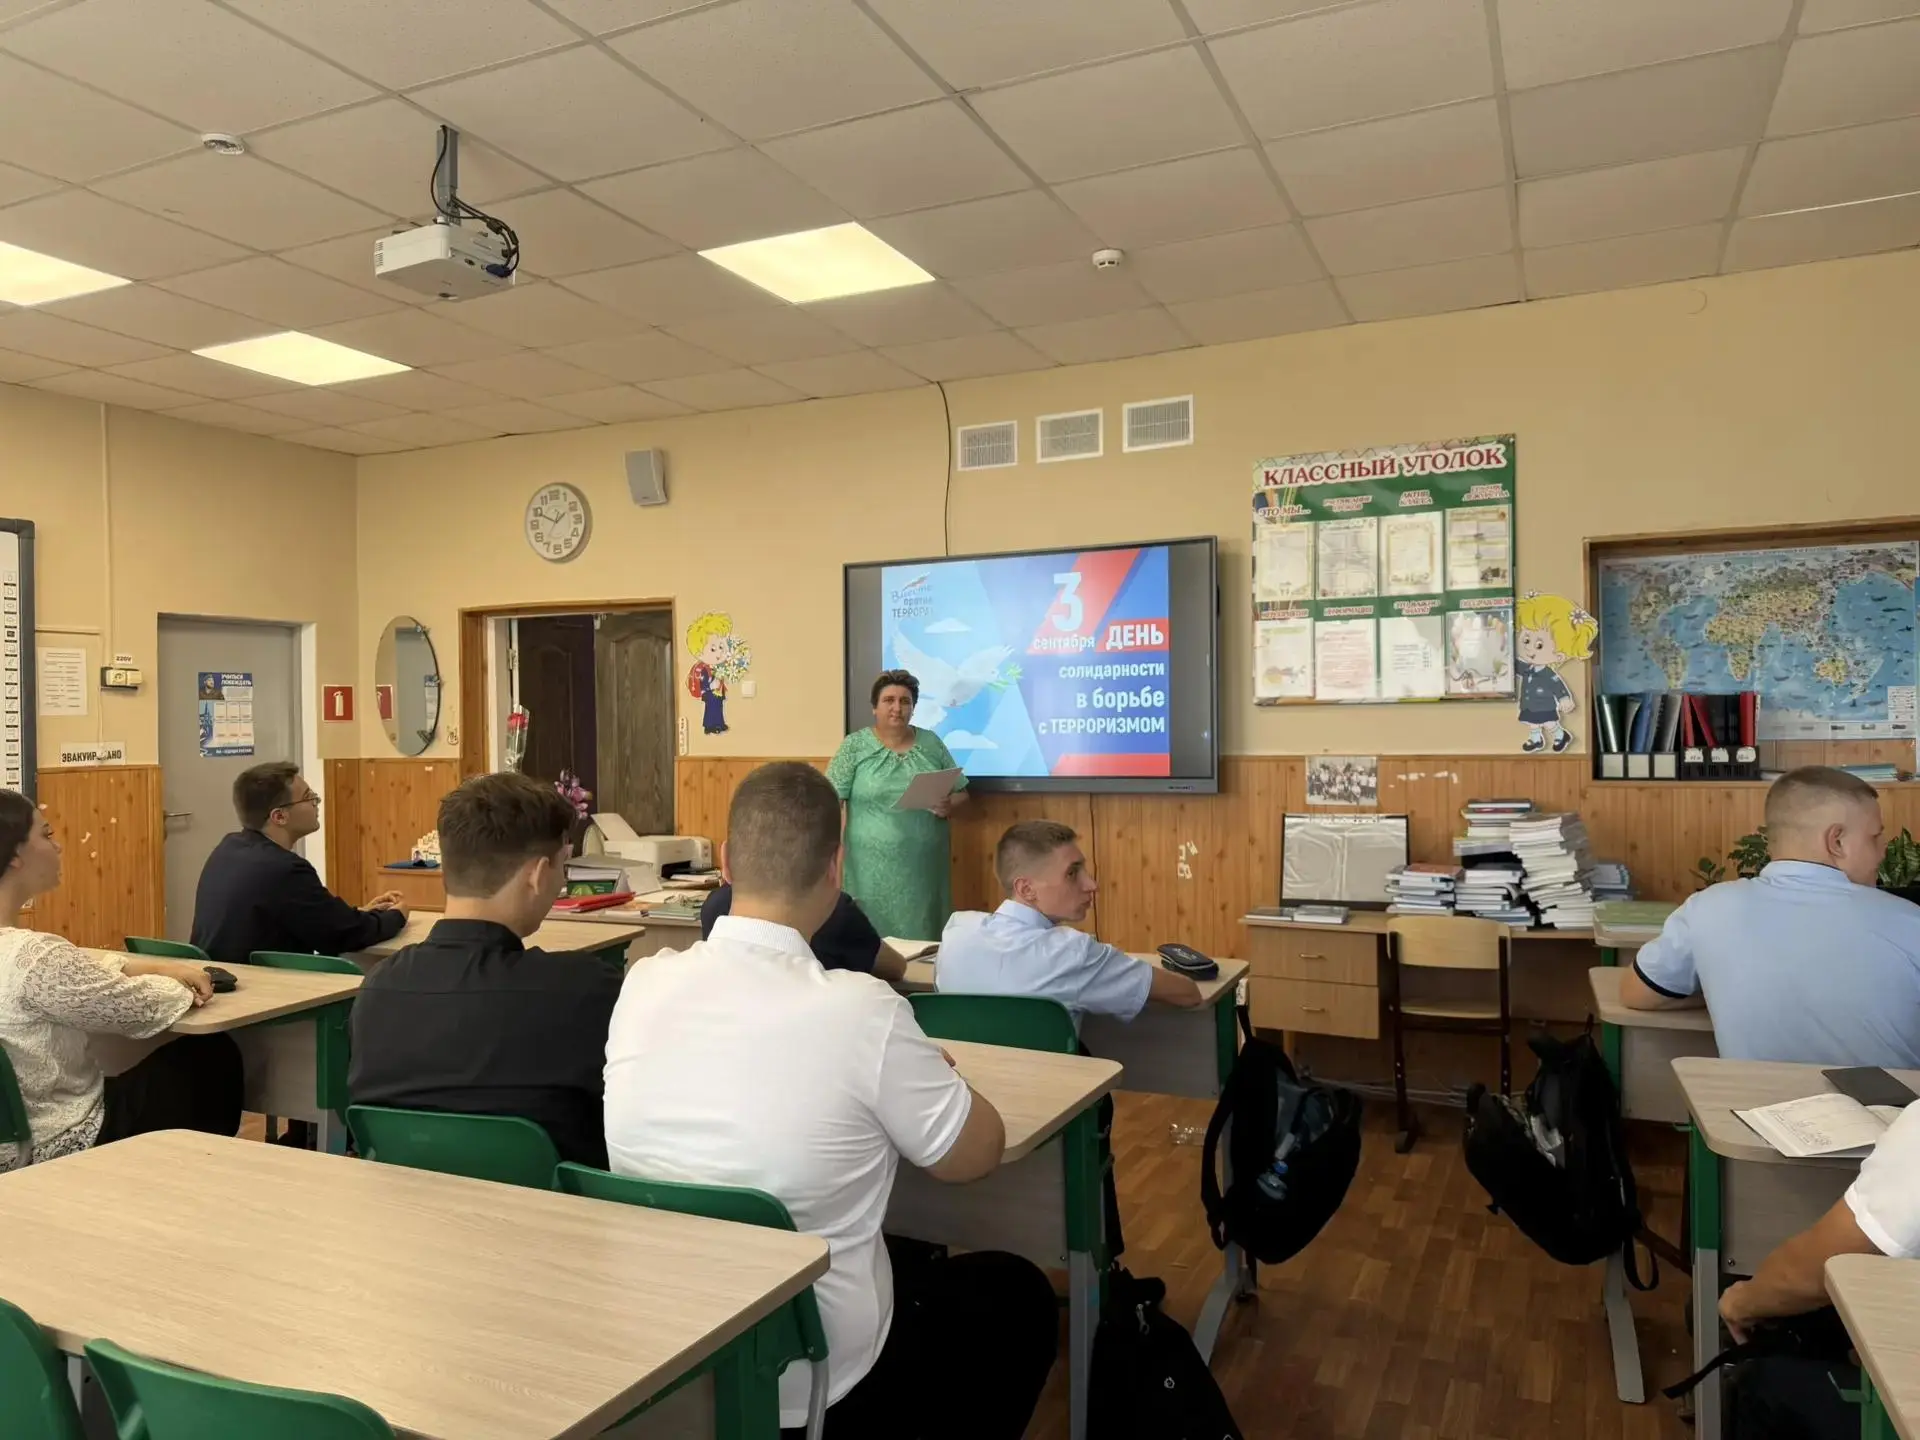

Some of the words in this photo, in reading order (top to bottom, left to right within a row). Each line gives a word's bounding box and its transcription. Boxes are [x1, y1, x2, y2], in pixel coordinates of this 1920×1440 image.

[1263, 455, 1396, 486] КЛАССНЫЙ
[1403, 447, 1503, 473] УГОЛОК
[540, 494, 548, 506] 11
[548, 489, 560, 501] 12
[562, 491, 568, 502] 1
[533, 507, 543, 517] 10
[568, 501, 578, 512] 2
[530, 519, 539, 530] 9
[573, 514, 582, 525] 3
[534, 532, 544, 543] 8
[571, 527, 580, 537] 4
[543, 541, 551, 552] 7
[553, 544, 562, 554] 6
[564, 538, 572, 549] 5
[1052, 571, 1083, 632] 3
[1033, 633, 1096, 653] сентября
[1105, 623, 1165, 650] ДЕНЬ
[1058, 662, 1165, 681] солидарности
[1076, 692, 1088, 708] в
[1092, 685, 1165, 712] борьбе
[1038, 722, 1048, 735] с
[1050, 716, 1165, 734] ТЕРРОРИЗМОМ
[61, 749, 122, 763] ЭВАКУИРАНО
